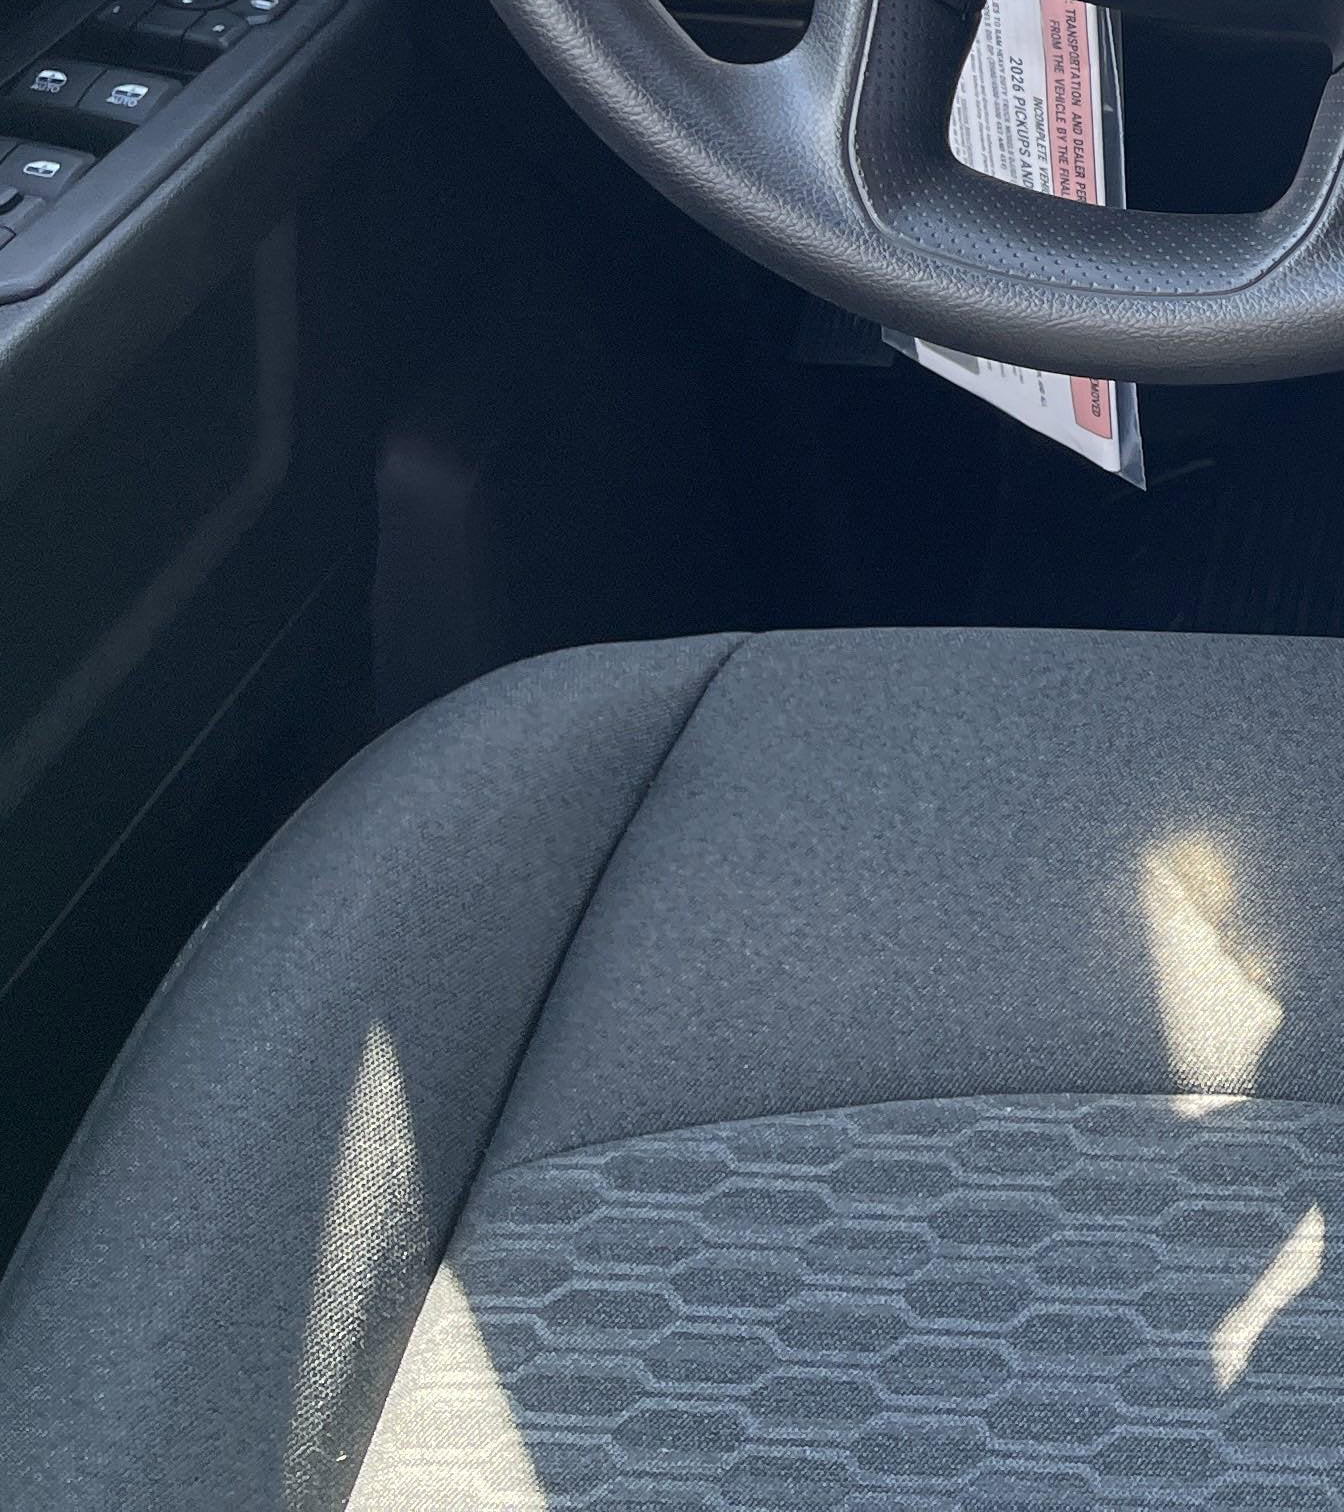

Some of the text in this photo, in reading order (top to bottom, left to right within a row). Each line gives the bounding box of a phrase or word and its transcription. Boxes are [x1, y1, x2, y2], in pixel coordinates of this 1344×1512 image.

[1067, 9, 1083, 106] TRANSPORTATION
[30, 81, 61, 93] AUTO
[105, 95, 138, 108] AUTO
[1051, 20, 1071, 196] FROM THE VEHICLE BY THE FINAL
[1011, 56, 1034, 188] 2026 PICKUPS AND
[1034, 97, 1049, 164] INCOMPLETE
[1073, 112, 1083, 134] AND
[1074, 139, 1086, 178] DEALER
